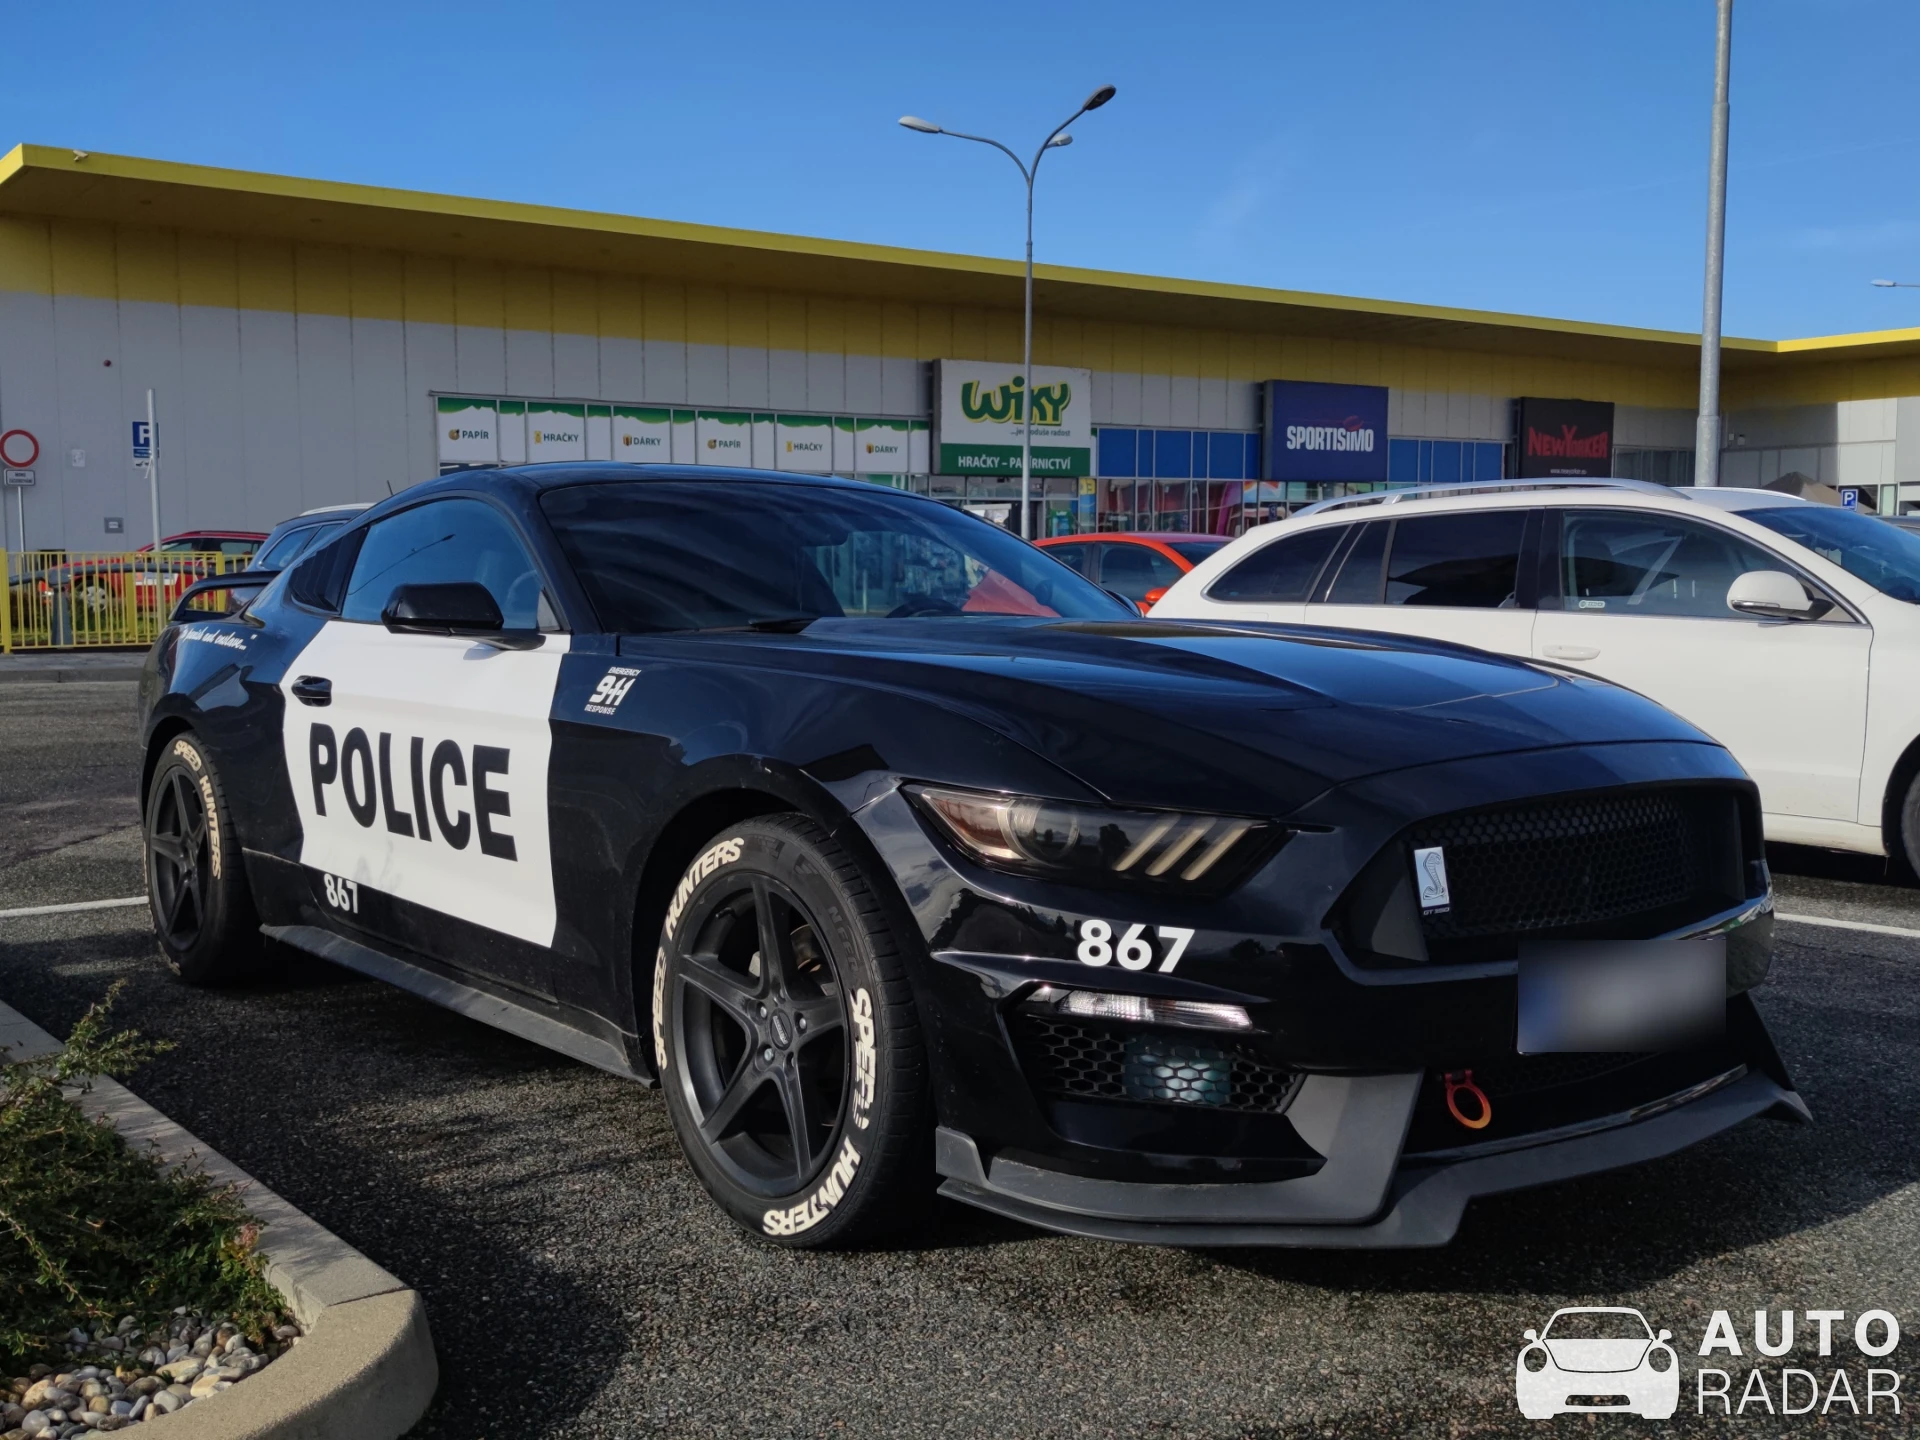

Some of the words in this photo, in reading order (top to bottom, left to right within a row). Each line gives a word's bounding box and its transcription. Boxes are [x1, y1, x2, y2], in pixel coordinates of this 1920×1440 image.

[462, 429, 489, 440] PAPÍR
[543, 432, 579, 443] HRAČKY
[633, 435, 661, 446] DÁRKY
[718, 439, 741, 449] PAPÍR
[793, 442, 823, 452] HRAČKY
[874, 444, 898, 454] DÁRKY
[958, 454, 1000, 469] HRAČKY
[1009, 456, 1071, 470] PAÍRNICTVÍ
[1844, 492, 1854, 505] P
[589, 675, 636, 706] 911
[584, 704, 617, 715] RESPONSE
[309, 722, 518, 862] POLICE
[173, 740, 202, 771] SPEED
[199, 774, 222, 880] HUNTERS
[323, 873, 358, 914] 867
[664, 837, 745, 941] HUNTERS
[1077, 919, 1196, 973] 867
[762, 1134, 863, 1236] HUNTERS
